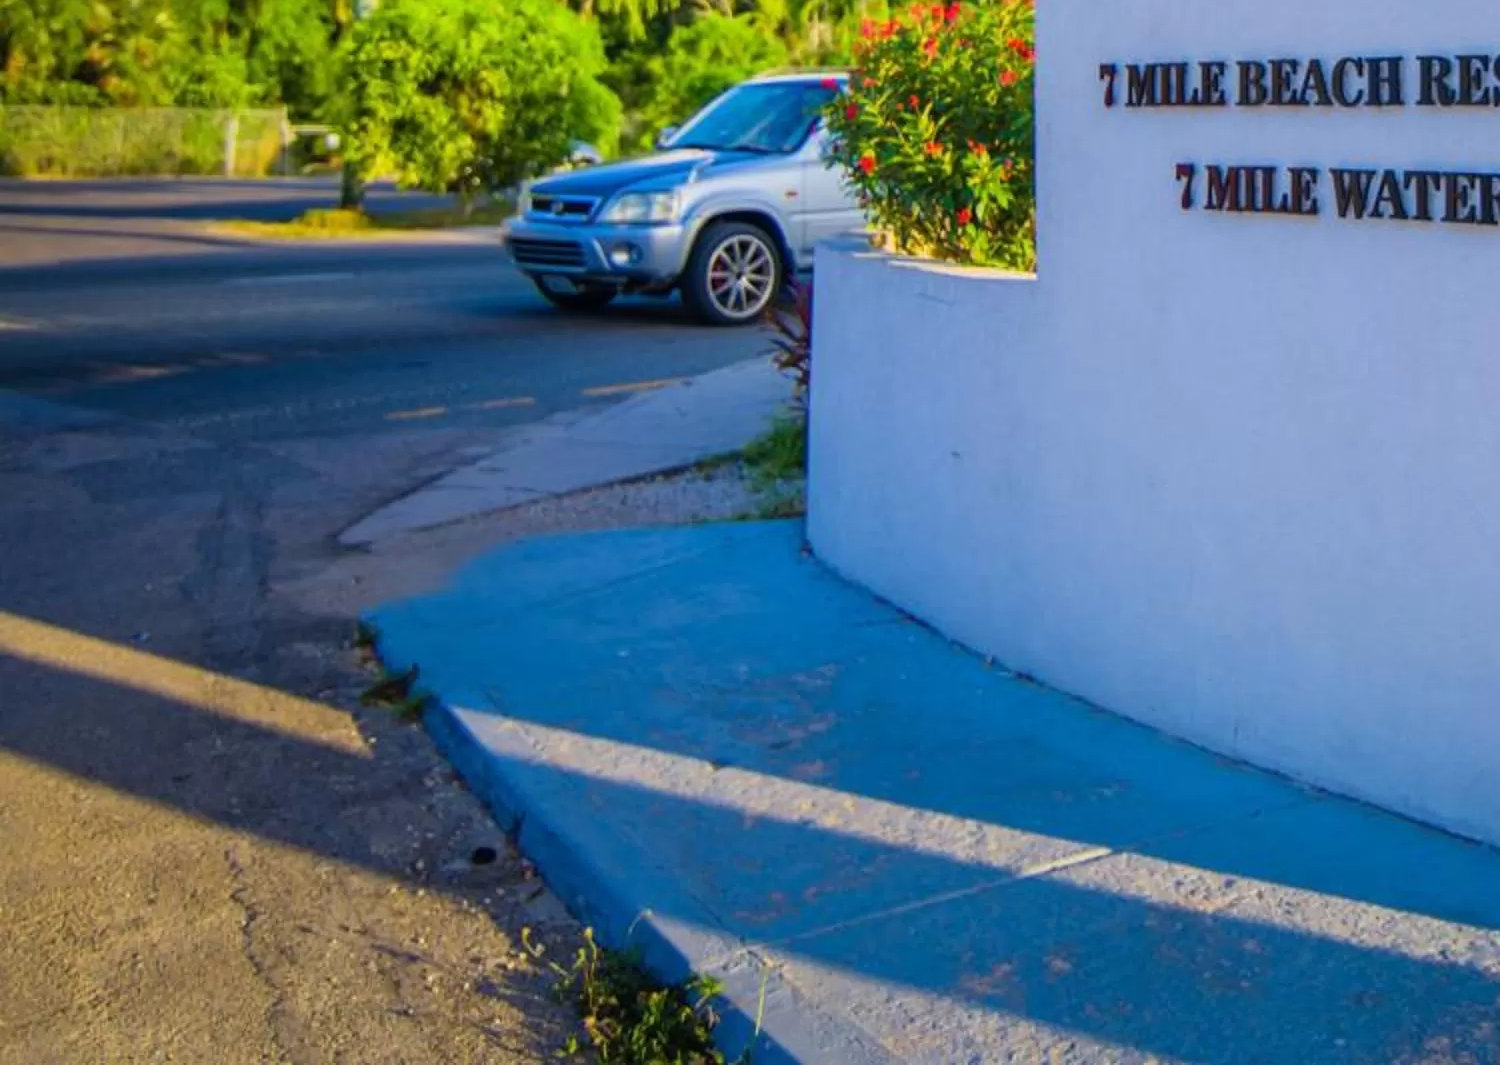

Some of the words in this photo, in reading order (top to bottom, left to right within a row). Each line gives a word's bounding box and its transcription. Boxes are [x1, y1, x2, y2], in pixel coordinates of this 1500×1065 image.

[1099, 63, 1117, 108] 7
[1125, 62, 1227, 109] MILE
[1235, 56, 1406, 109] BEACH
[1175, 163, 1196, 210] 7
[1204, 164, 1320, 216] MILE
